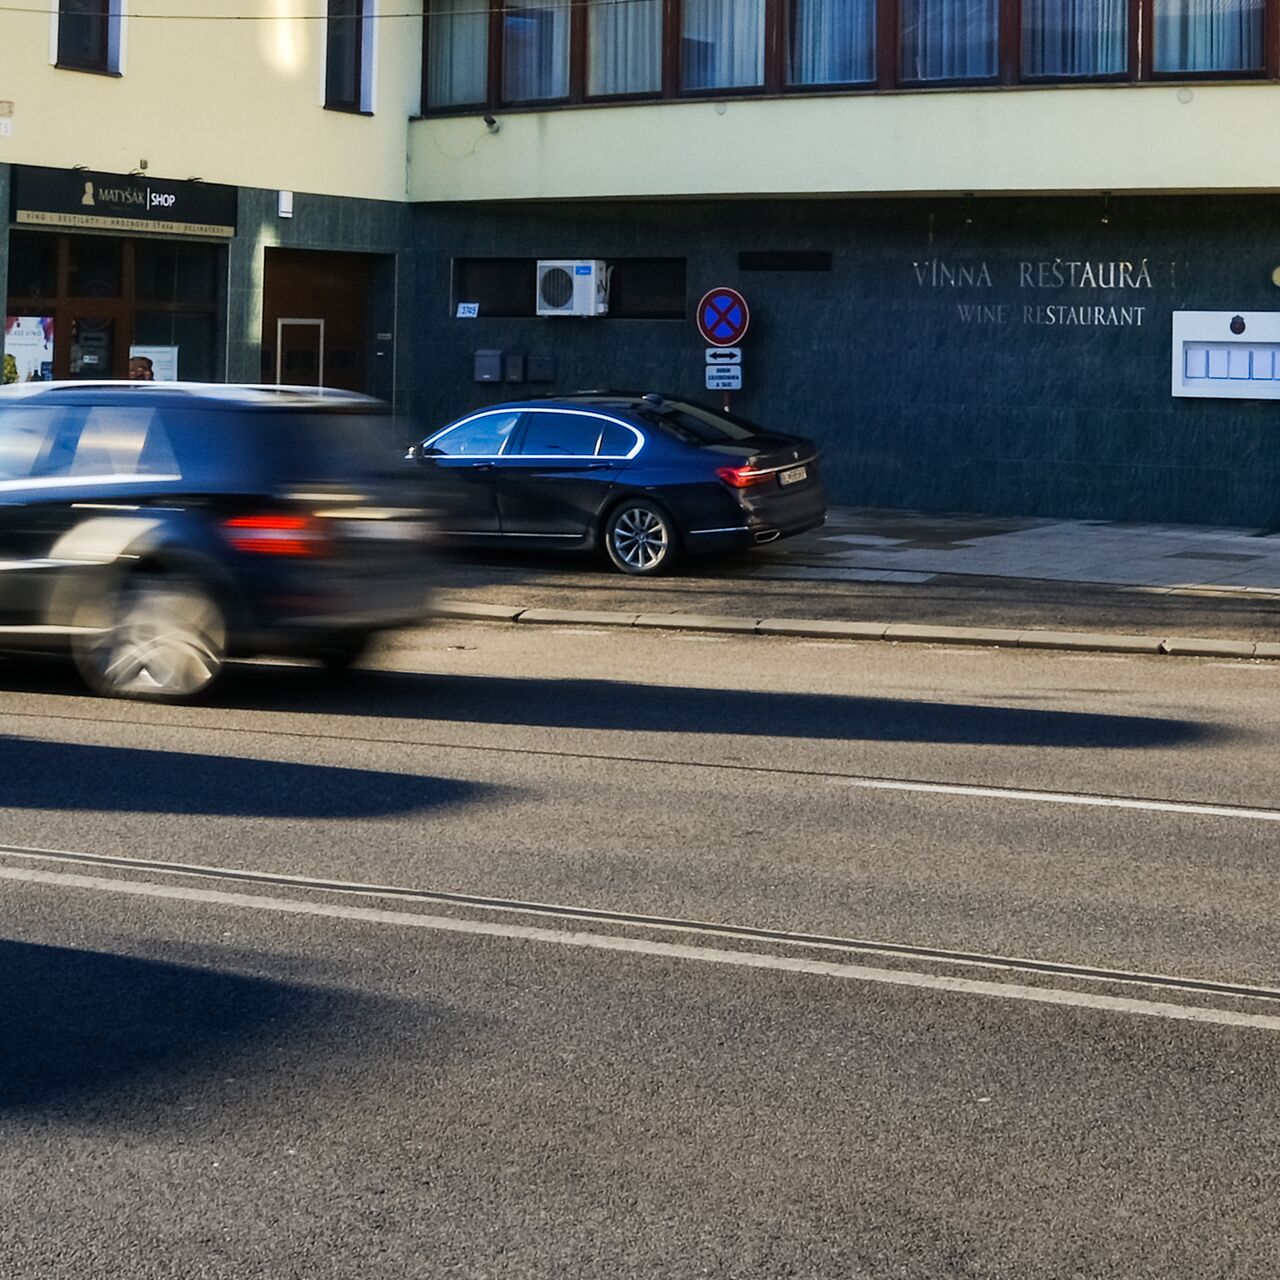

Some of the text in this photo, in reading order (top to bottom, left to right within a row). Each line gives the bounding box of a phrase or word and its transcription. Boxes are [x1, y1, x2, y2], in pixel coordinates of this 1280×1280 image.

[98, 187, 176, 207] MATYŠÁK SHOP
[957, 304, 1146, 326] WINE RESTAURANT
